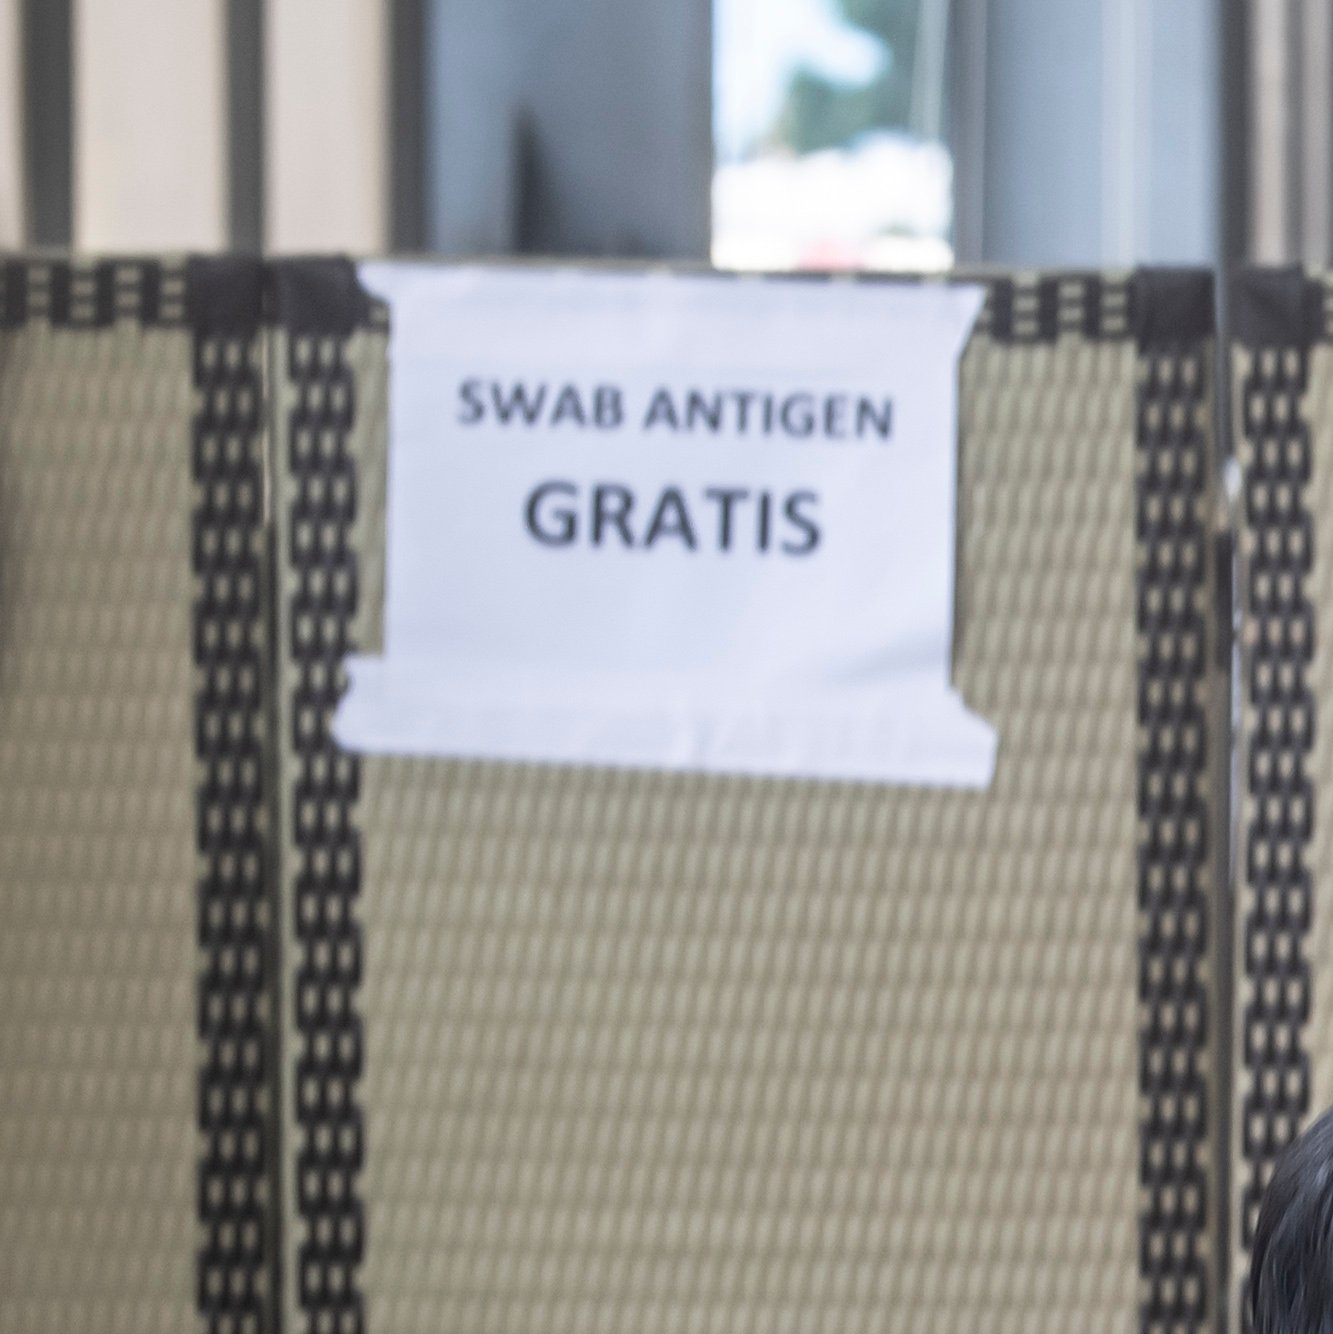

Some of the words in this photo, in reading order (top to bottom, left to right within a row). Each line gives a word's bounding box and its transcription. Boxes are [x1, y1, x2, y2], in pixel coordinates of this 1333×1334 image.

[456, 377, 625, 431] SWAB
[642, 387, 894, 441] ANTIGEN
[523, 480, 822, 557] GRATIS
